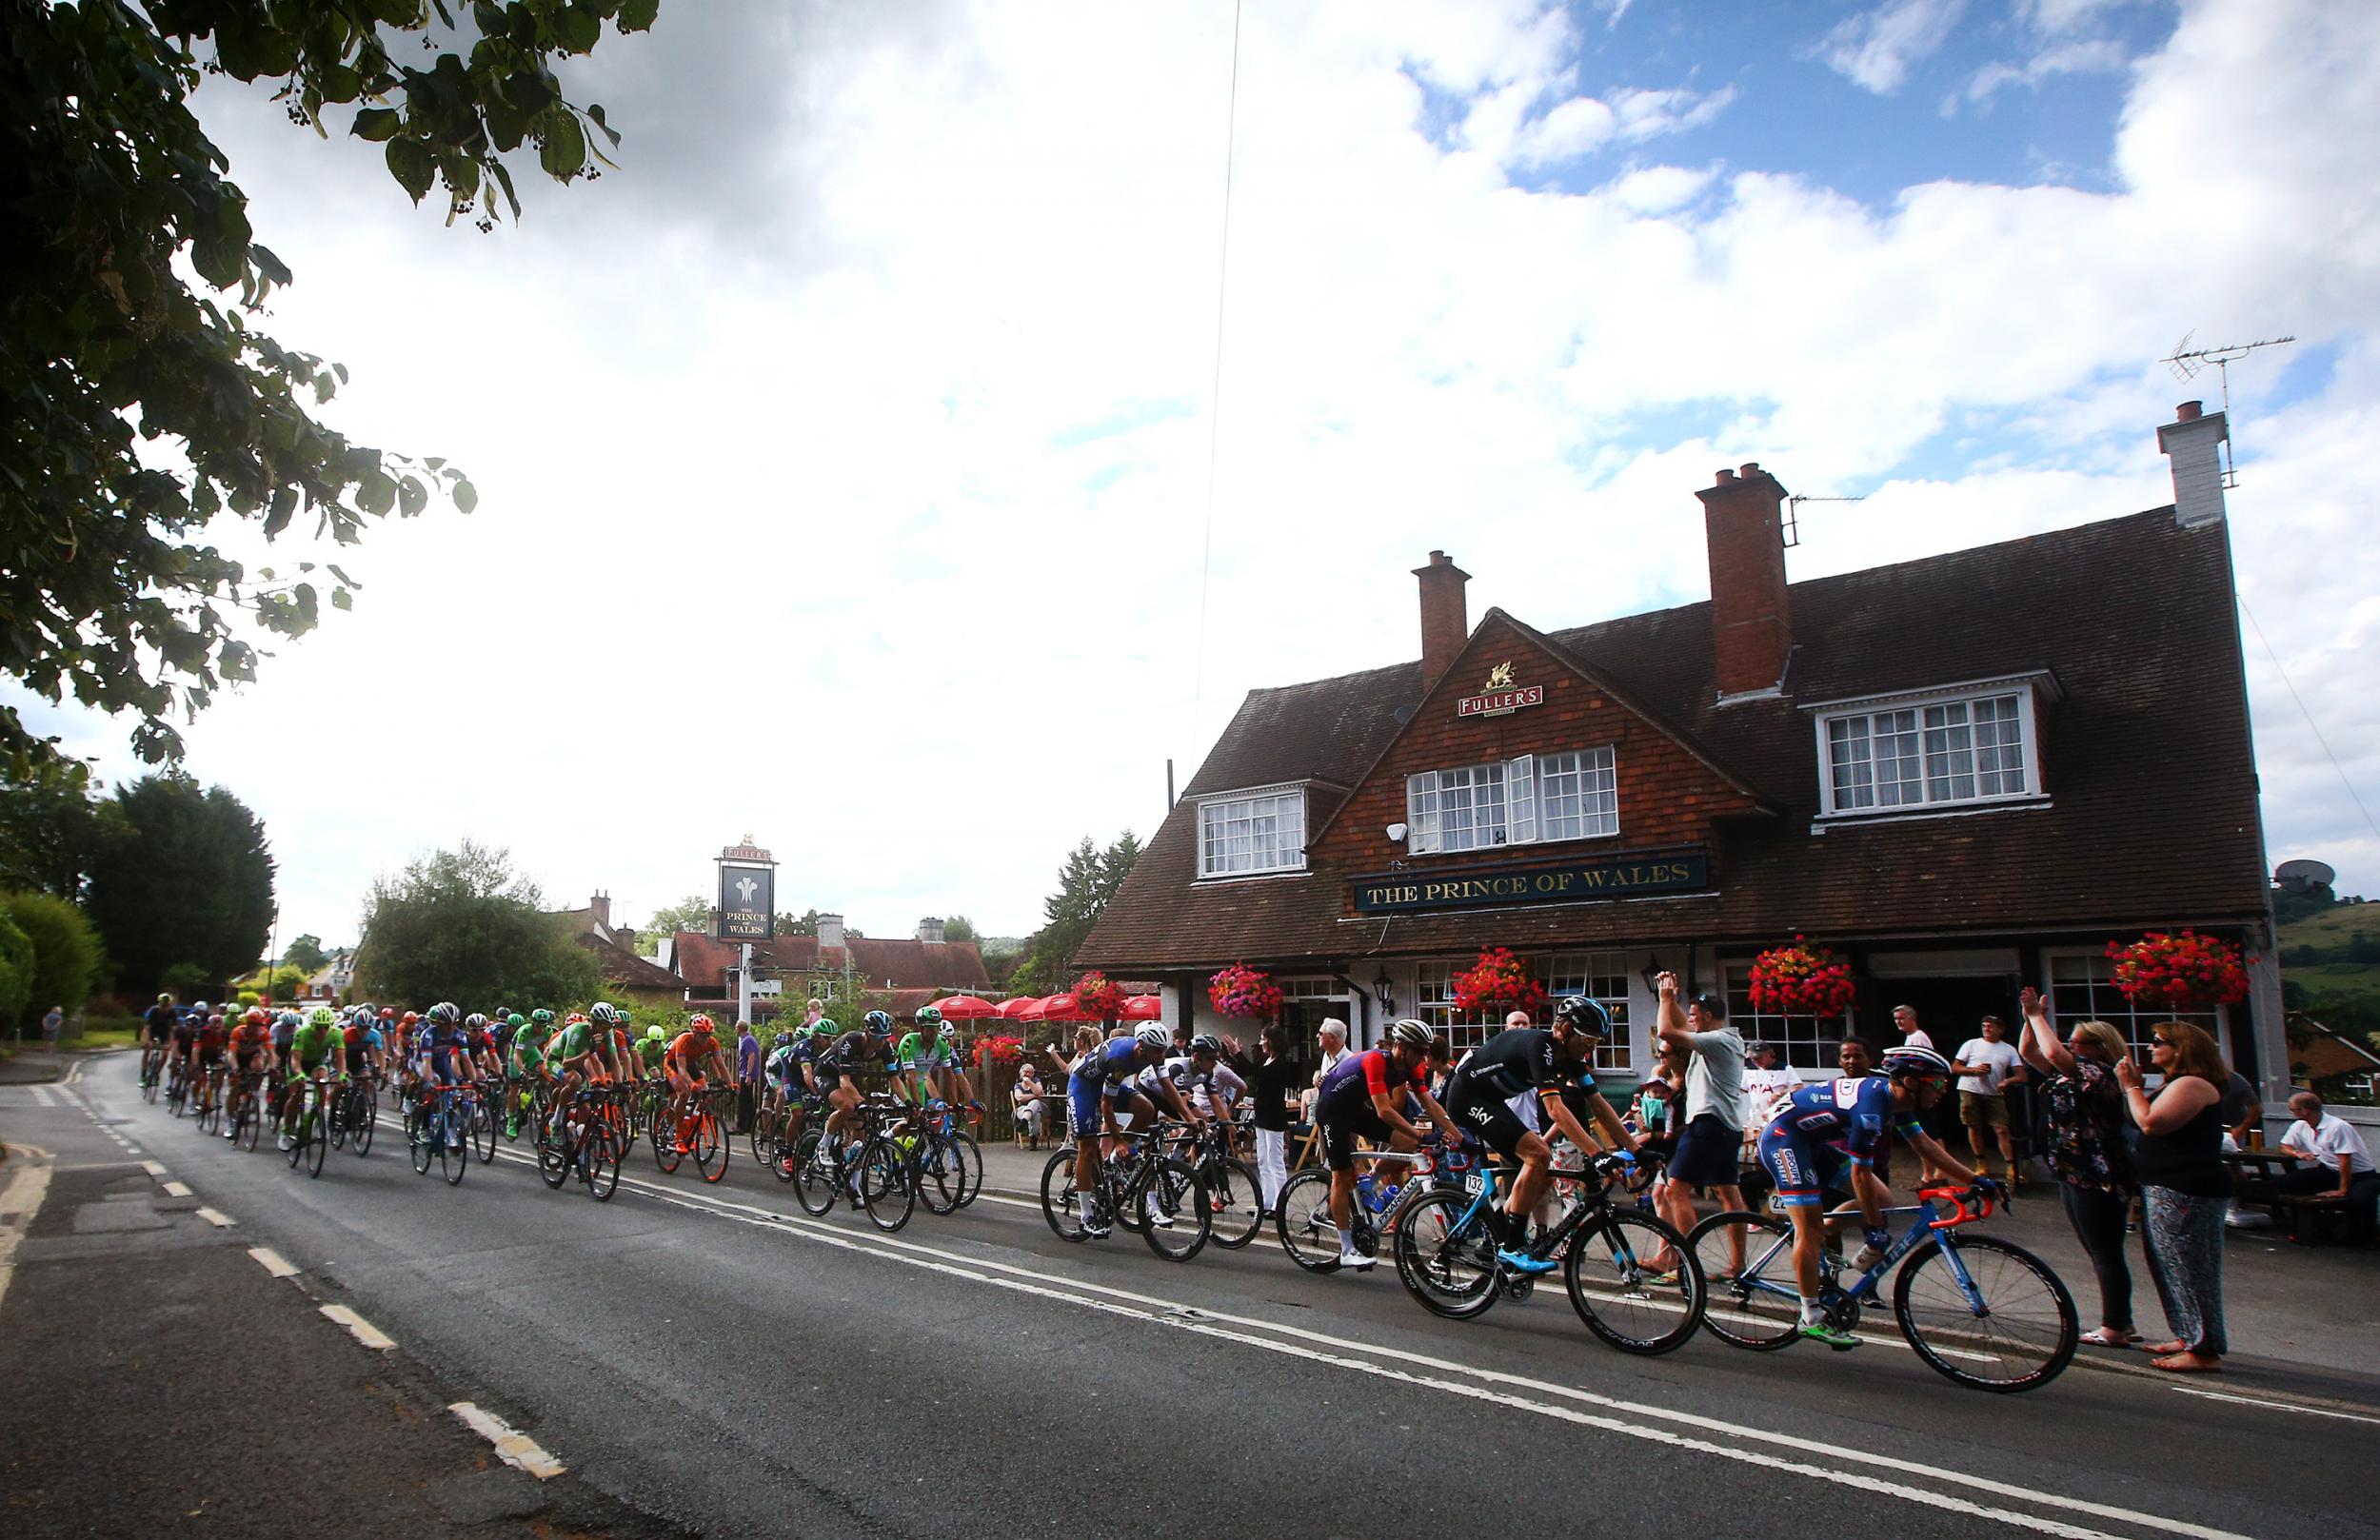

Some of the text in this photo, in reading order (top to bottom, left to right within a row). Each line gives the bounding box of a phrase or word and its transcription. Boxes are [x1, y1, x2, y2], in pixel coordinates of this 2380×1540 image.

[1461, 688, 1537, 713] FULLER'S
[1367, 863, 1690, 905] THE PRINCE OF WALES
[726, 912, 767, 922] PRINCE
[729, 925, 764, 934] WALES
[1542, 1042, 1555, 1067] sky
[1467, 1106, 1495, 1126] sky
[1594, 1156, 1612, 1169] sky
[1784, 1149, 1801, 1185] GROUPE
[1467, 1175, 1483, 1192] 132
[1378, 1177, 1418, 1225] PINARELLO
[1871, 1233, 1919, 1278] CUBE
